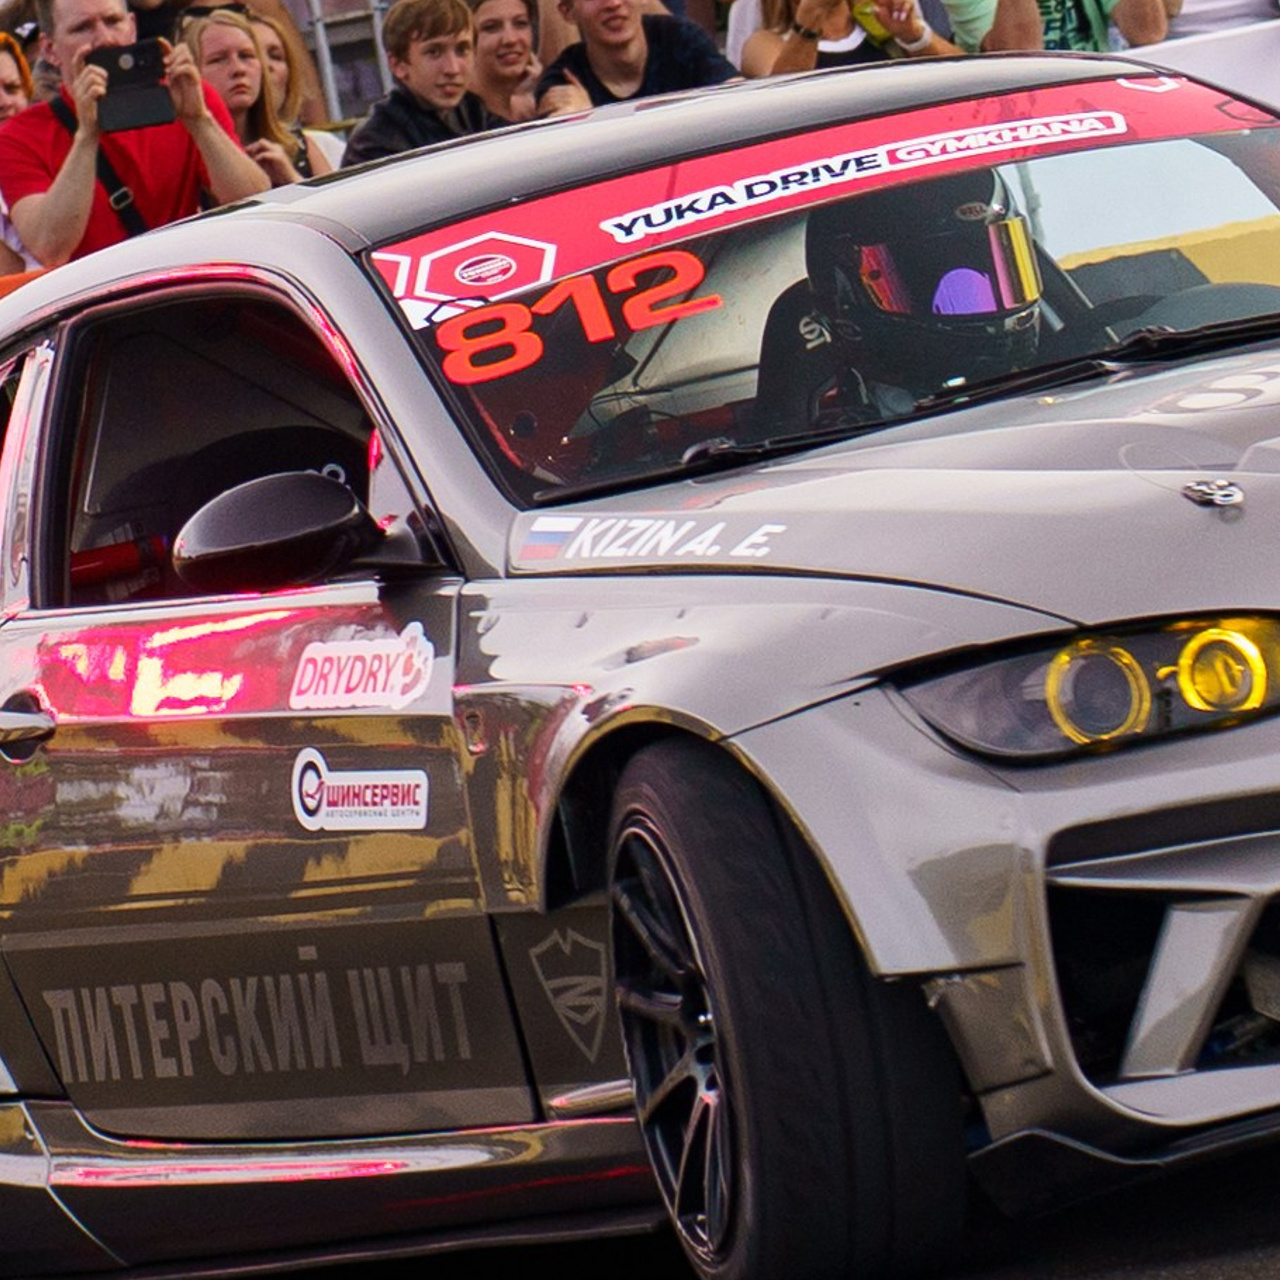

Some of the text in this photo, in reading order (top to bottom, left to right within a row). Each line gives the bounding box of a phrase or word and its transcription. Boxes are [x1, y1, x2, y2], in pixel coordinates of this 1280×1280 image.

[612, 116, 1108, 238] YUKA DRIVE GYMKHANA
[434, 250, 723, 386] 812
[564, 518, 697, 559] KIZIN
[295, 652, 401, 697] DRYDRY
[325, 783, 422, 808] ШИНСЕРВИС
[41, 944, 472, 1084] ПИТЕРСКИЙ ЩИТ
